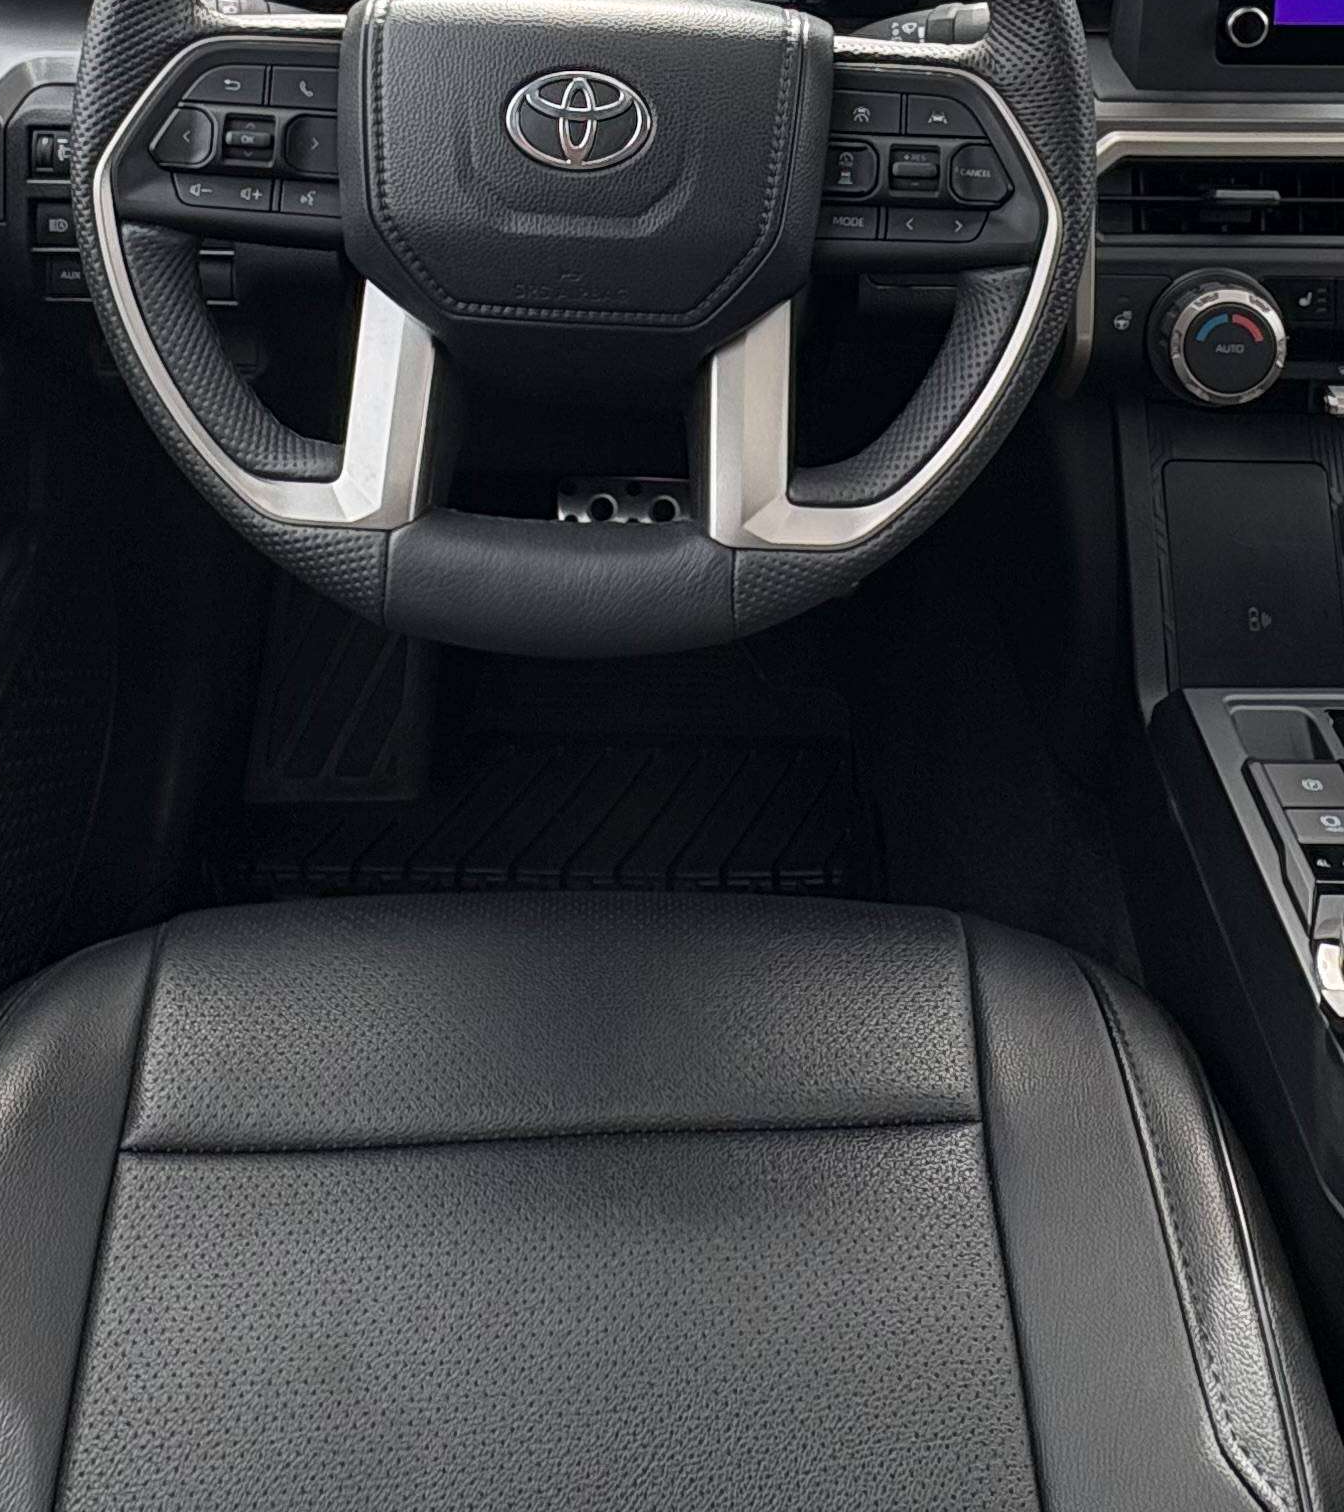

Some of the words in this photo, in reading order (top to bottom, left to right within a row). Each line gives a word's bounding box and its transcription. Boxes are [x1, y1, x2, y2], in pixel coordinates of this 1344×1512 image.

[960, 168, 992, 178] CANCEL
[833, 216, 865, 228] MODE
[60, 270, 81, 280] AUX
[1215, 344, 1245, 354] AUTO
[1316, 858, 1331, 868] 4L
